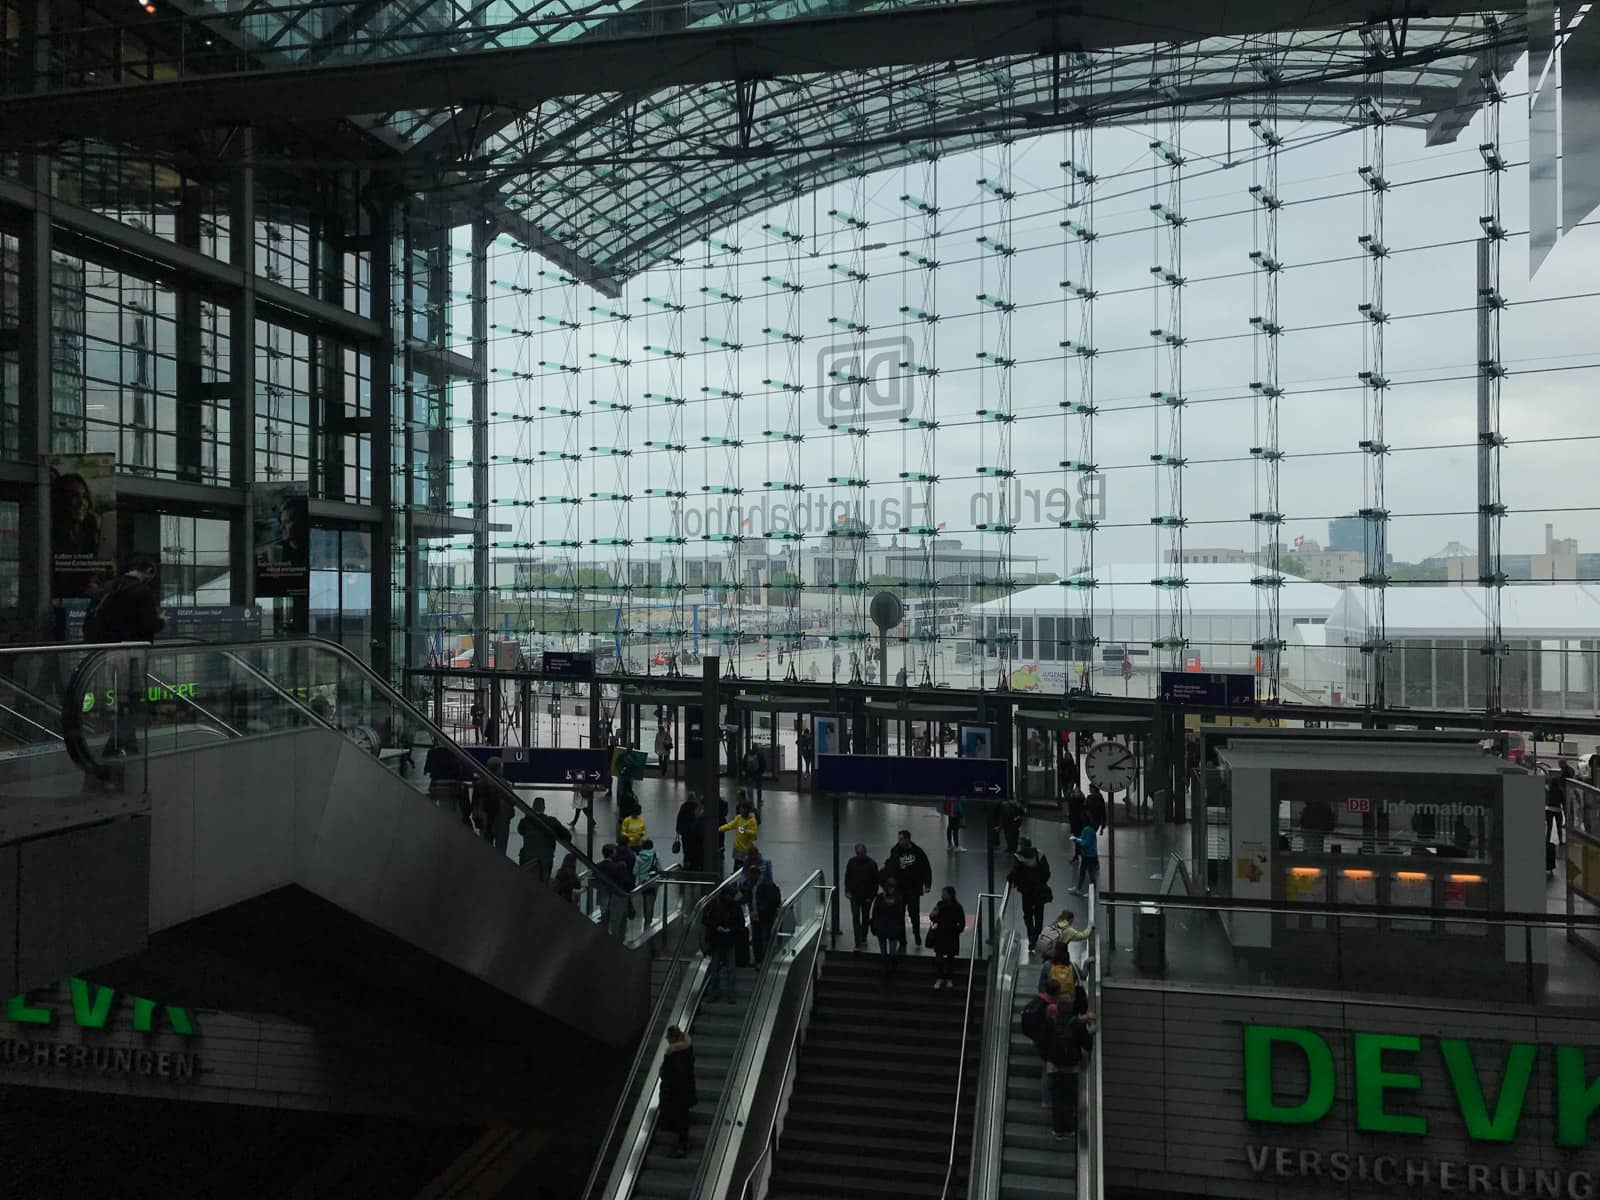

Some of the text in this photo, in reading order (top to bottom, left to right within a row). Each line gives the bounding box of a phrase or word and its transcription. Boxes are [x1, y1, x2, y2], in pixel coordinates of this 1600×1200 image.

[1348, 799, 1486, 817] DB Information
[1246, 1143, 1593, 1200] VERSICHERUNG
